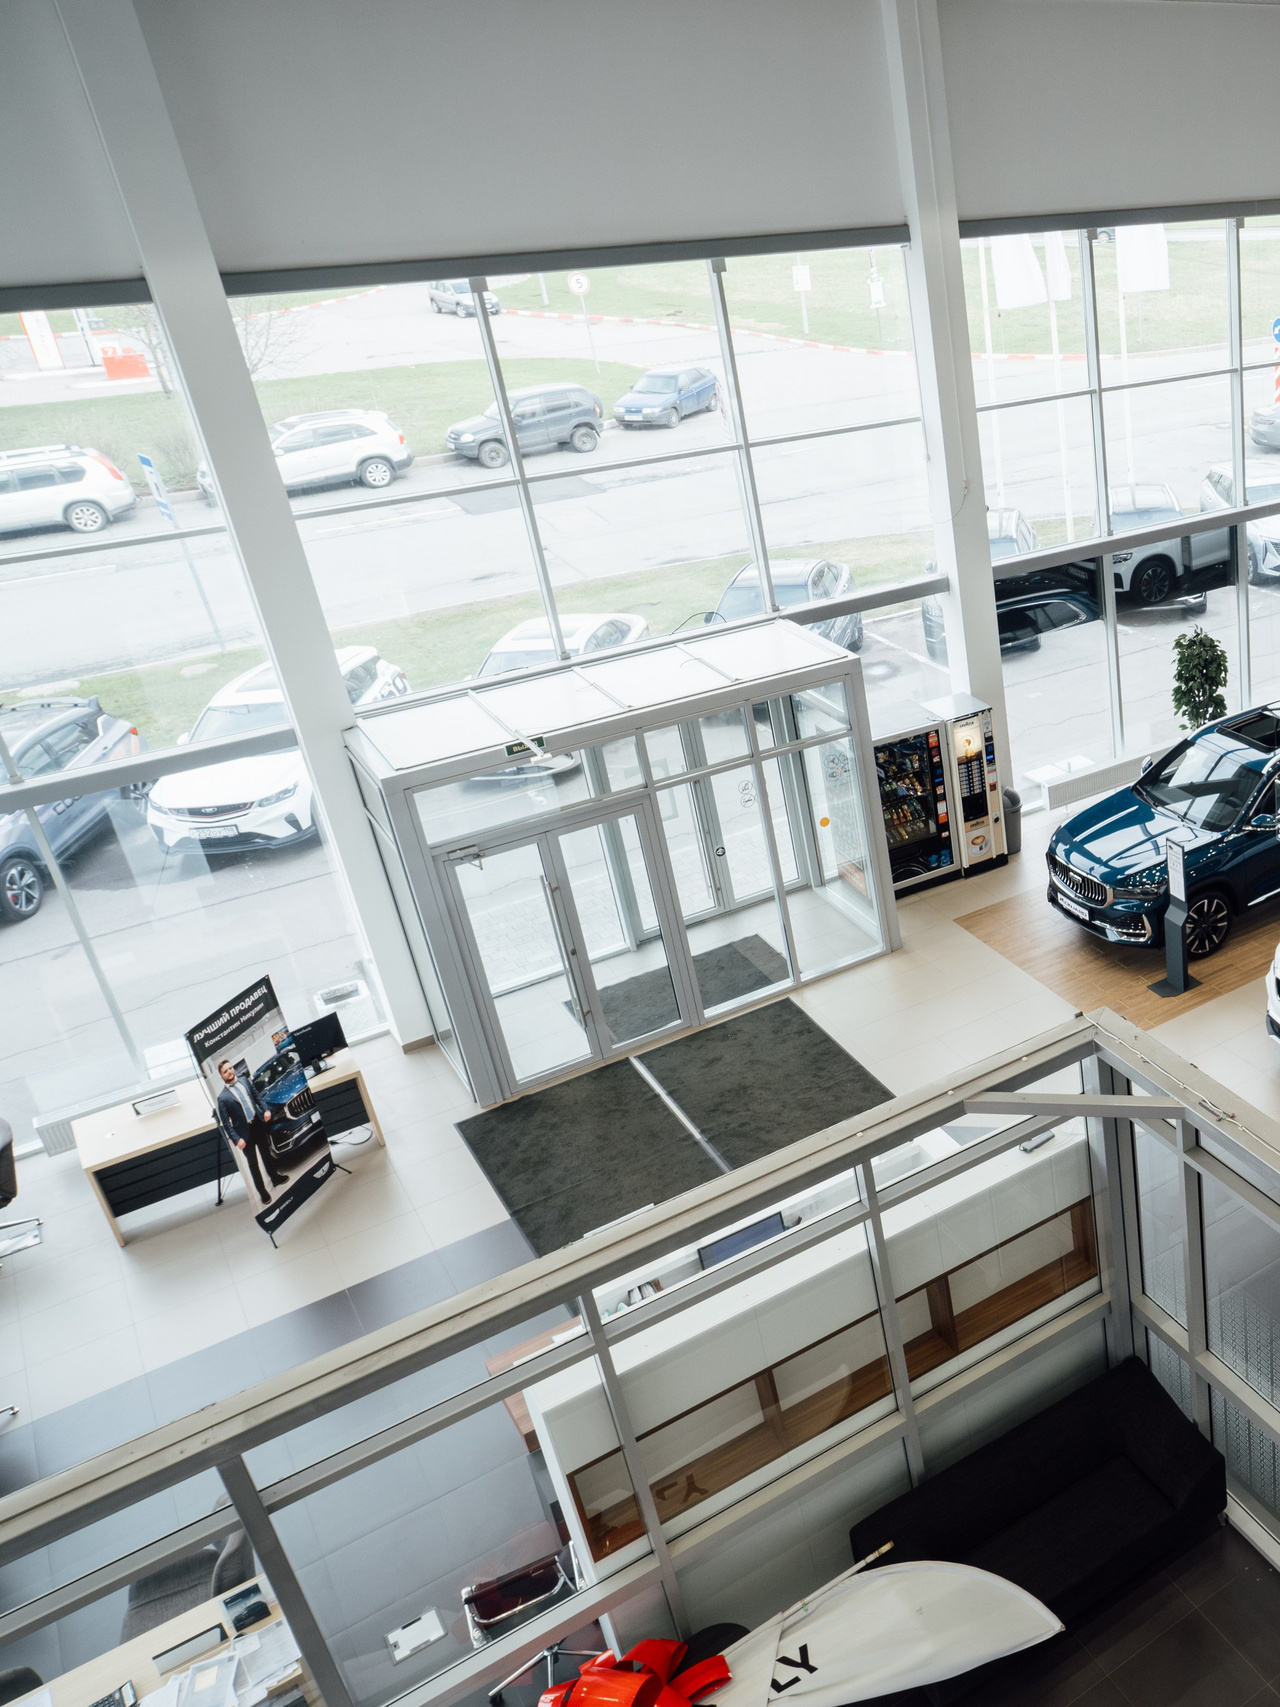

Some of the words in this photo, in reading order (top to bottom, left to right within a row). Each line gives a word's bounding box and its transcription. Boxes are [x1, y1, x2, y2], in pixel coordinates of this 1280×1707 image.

[576, 279, 583, 289] 5
[193, 1011, 231, 1043] ЛУЧШИЙ
[230, 985, 268, 1018] ПРОДАВЕЦ
[204, 1020, 241, 1048] Константин
[240, 1002, 265, 1023] Никулин
